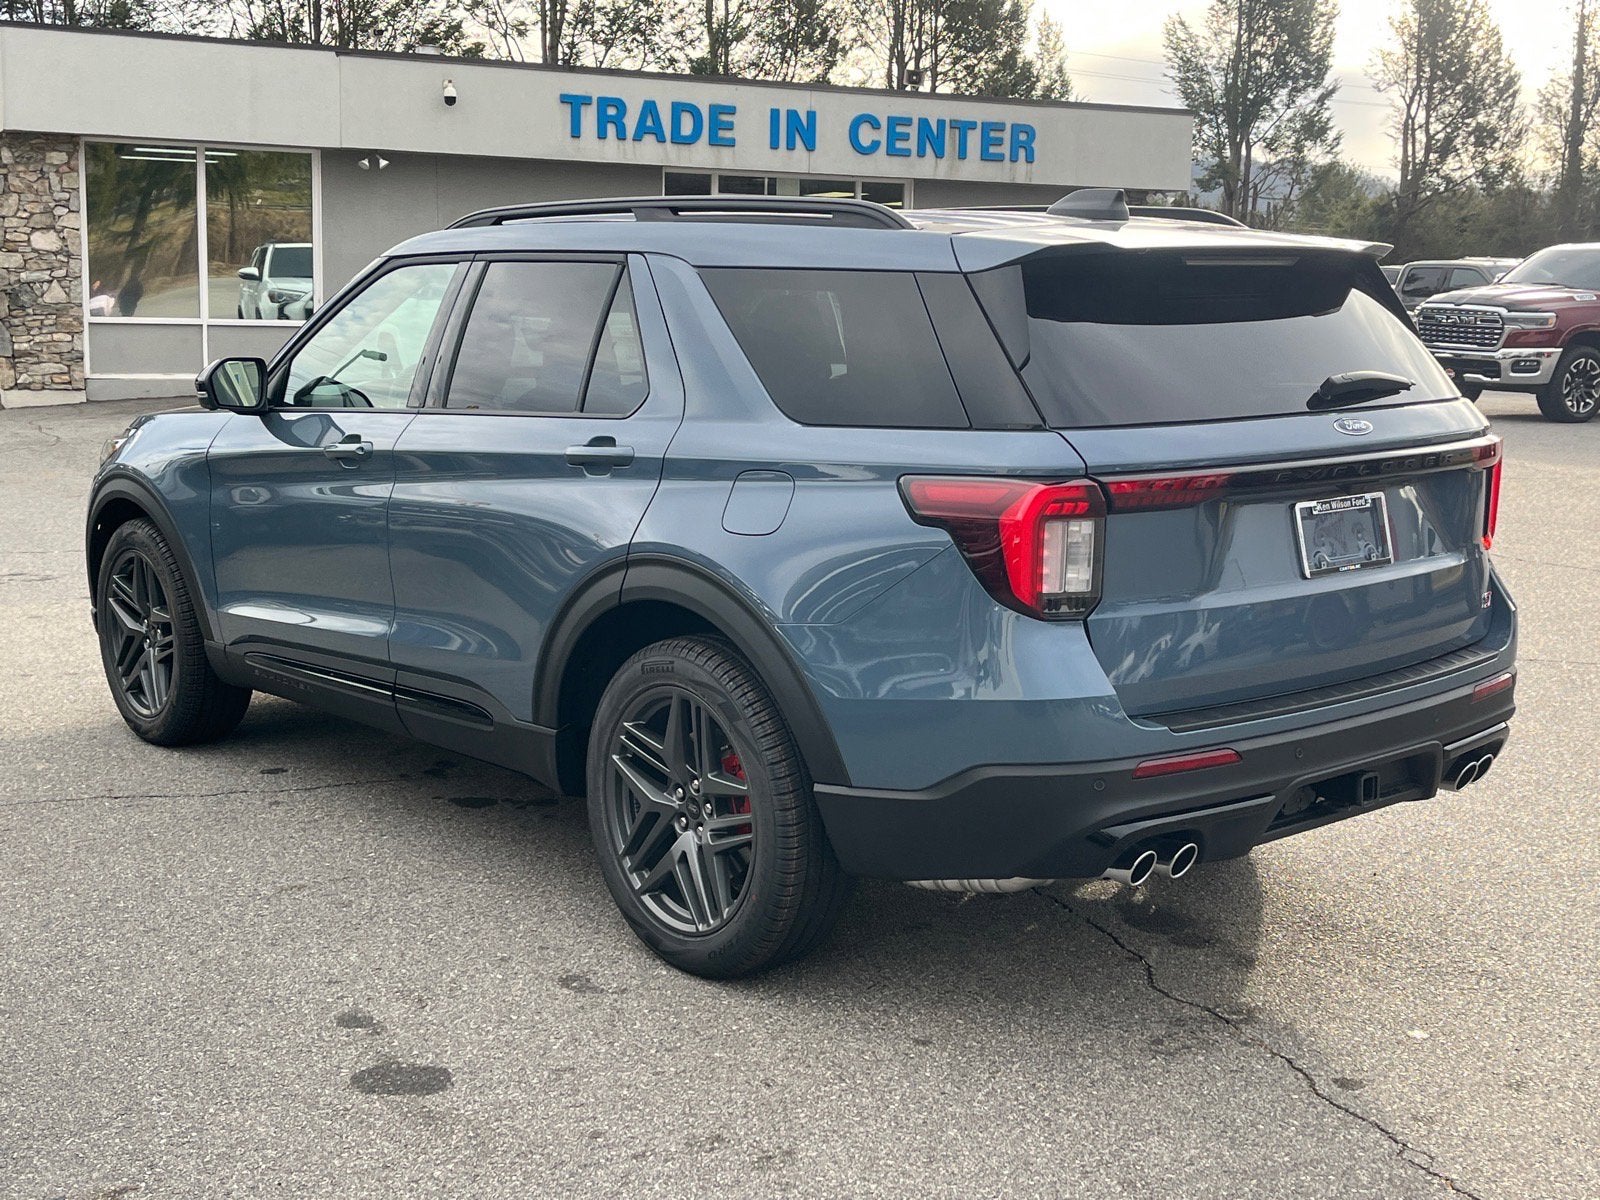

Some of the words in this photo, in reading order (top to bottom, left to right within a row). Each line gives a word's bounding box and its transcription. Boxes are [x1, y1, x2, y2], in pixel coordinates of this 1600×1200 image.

[560, 93, 736, 147] TRADE
[769, 108, 816, 151] IN
[849, 113, 1036, 163] CENTER
[1434, 315, 1475, 324] RAM
[1317, 502, 1331, 511] Ken
[1331, 499, 1351, 509] Wilson
[1352, 497, 1366, 507] Ford
